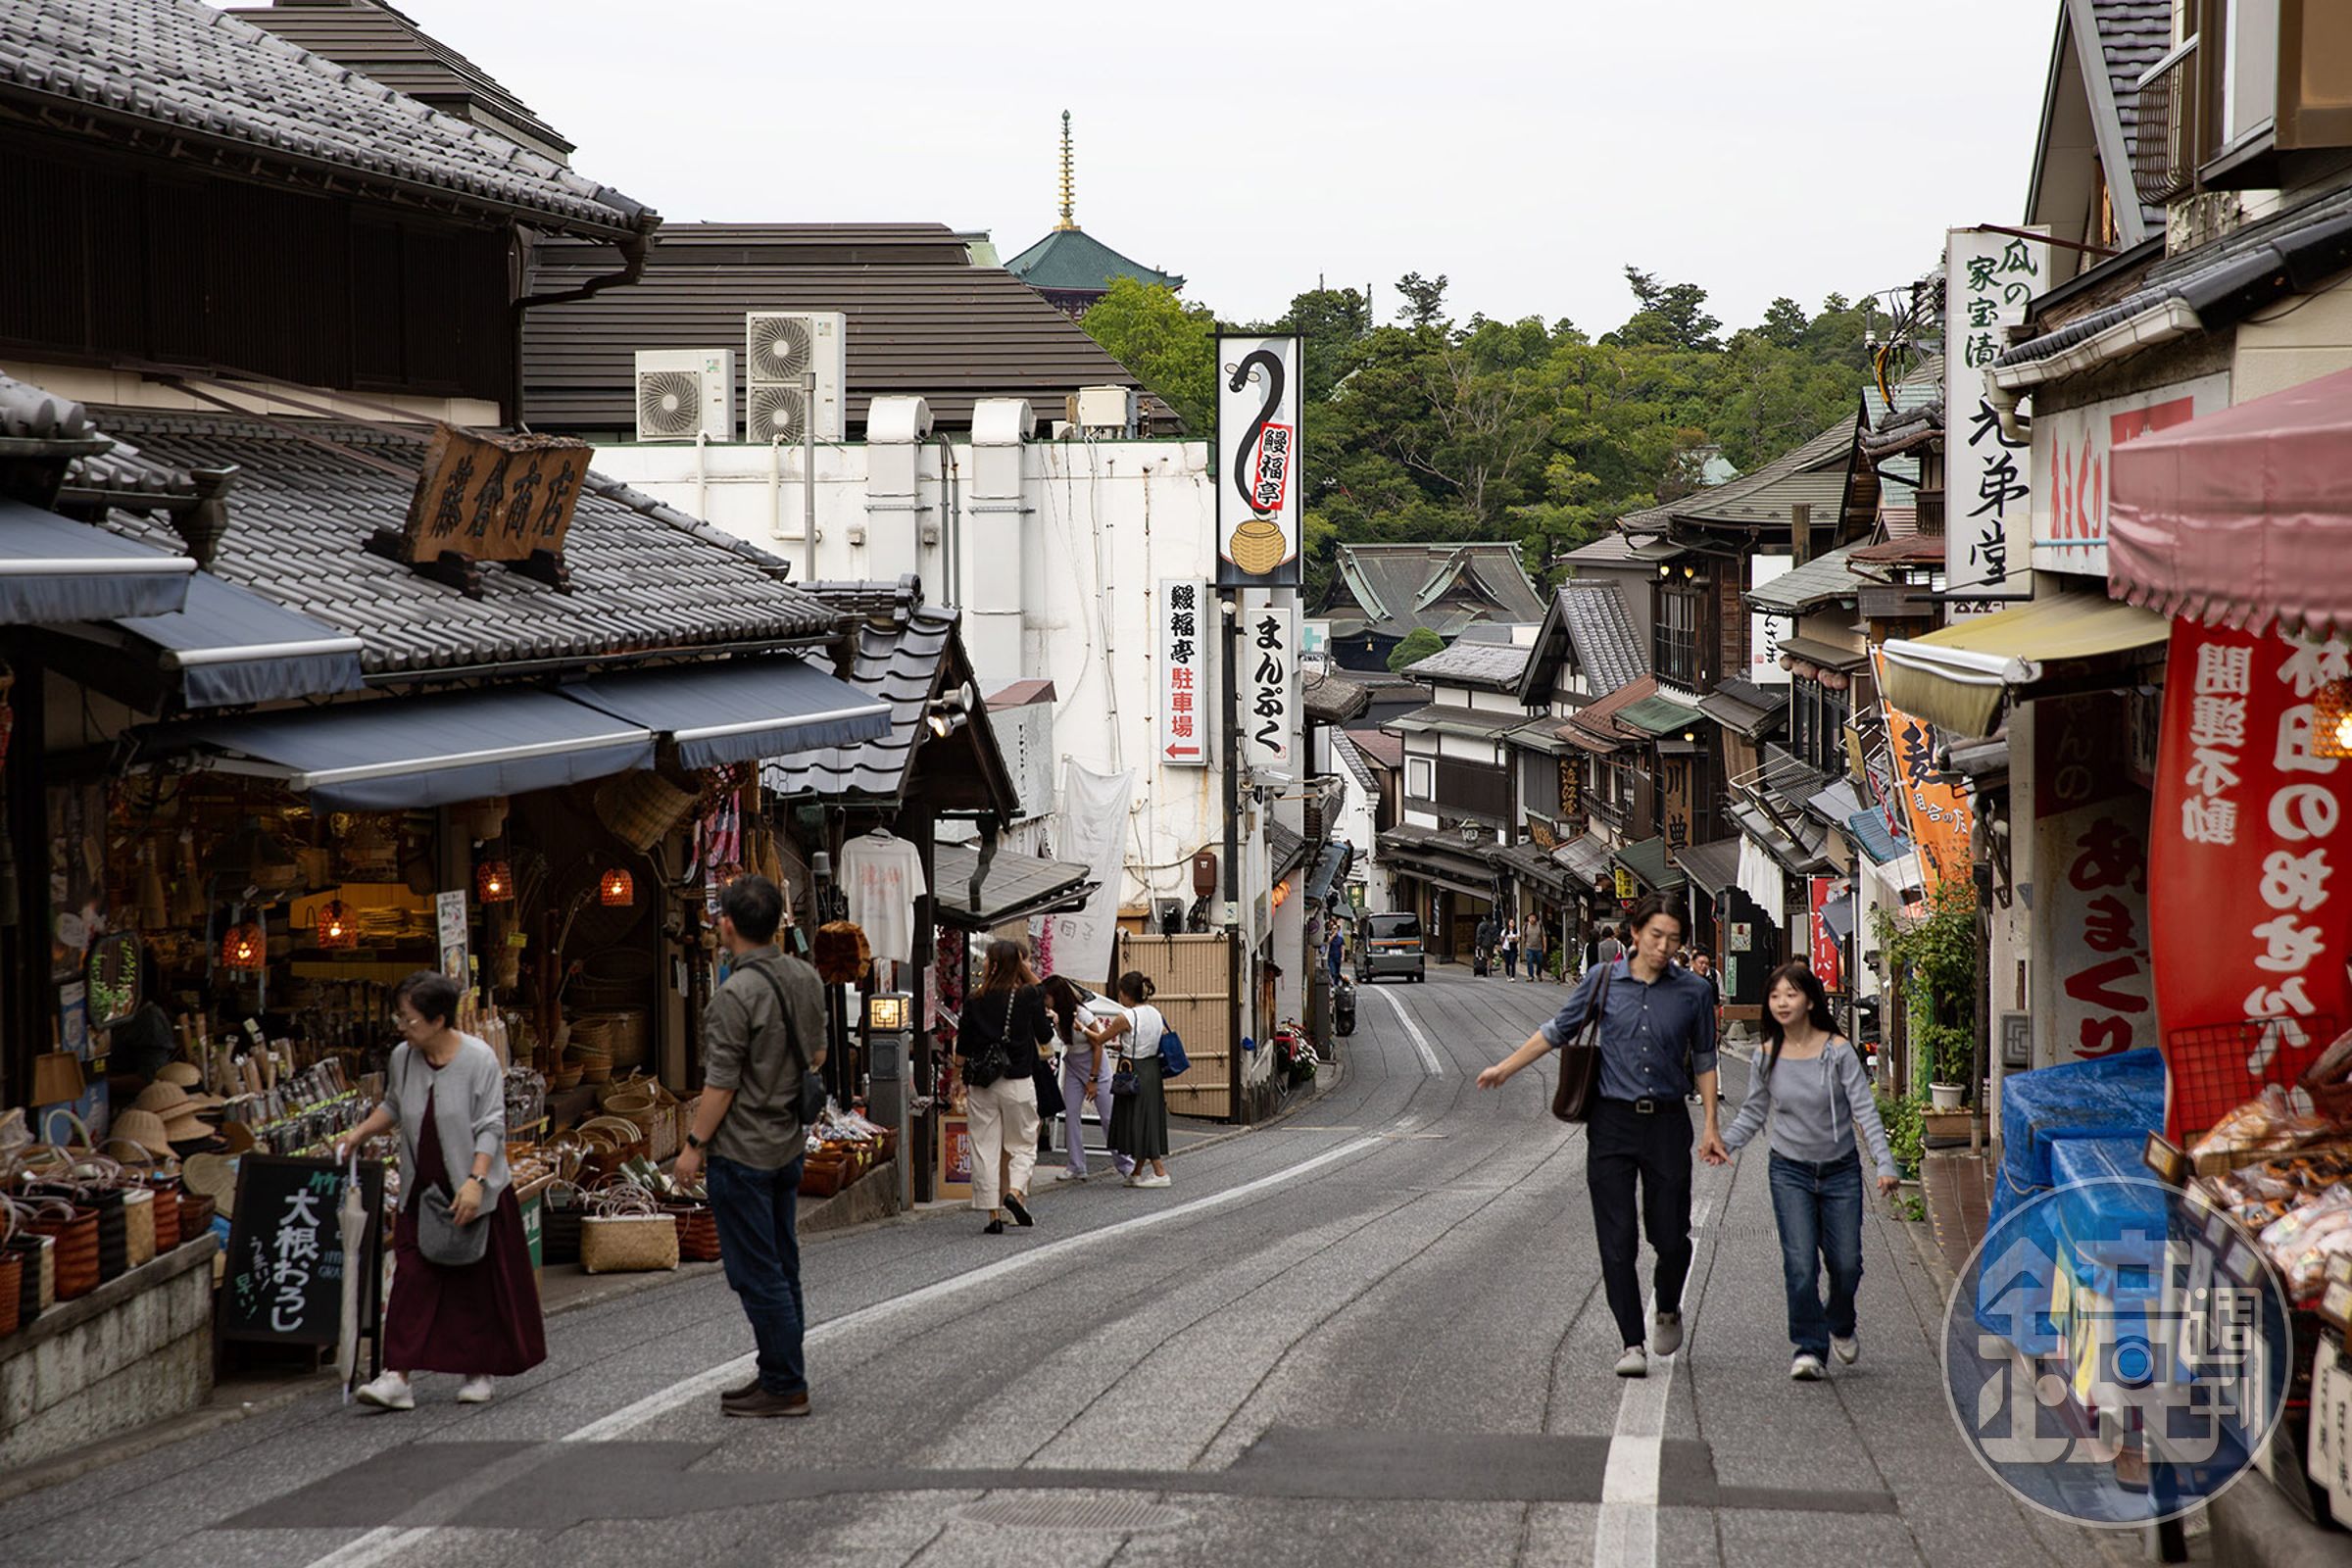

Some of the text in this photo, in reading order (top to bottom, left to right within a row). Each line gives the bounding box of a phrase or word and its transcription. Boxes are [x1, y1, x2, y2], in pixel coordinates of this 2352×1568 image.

[1965, 255, 2003, 369] 家宝漬
[1995, 237, 2038, 307] 瓜の
[1256, 427, 1290, 507] 鰻福亭
[1252, 614, 1285, 755] まんぷく
[270, 1188, 321, 1332] 大根おろし
